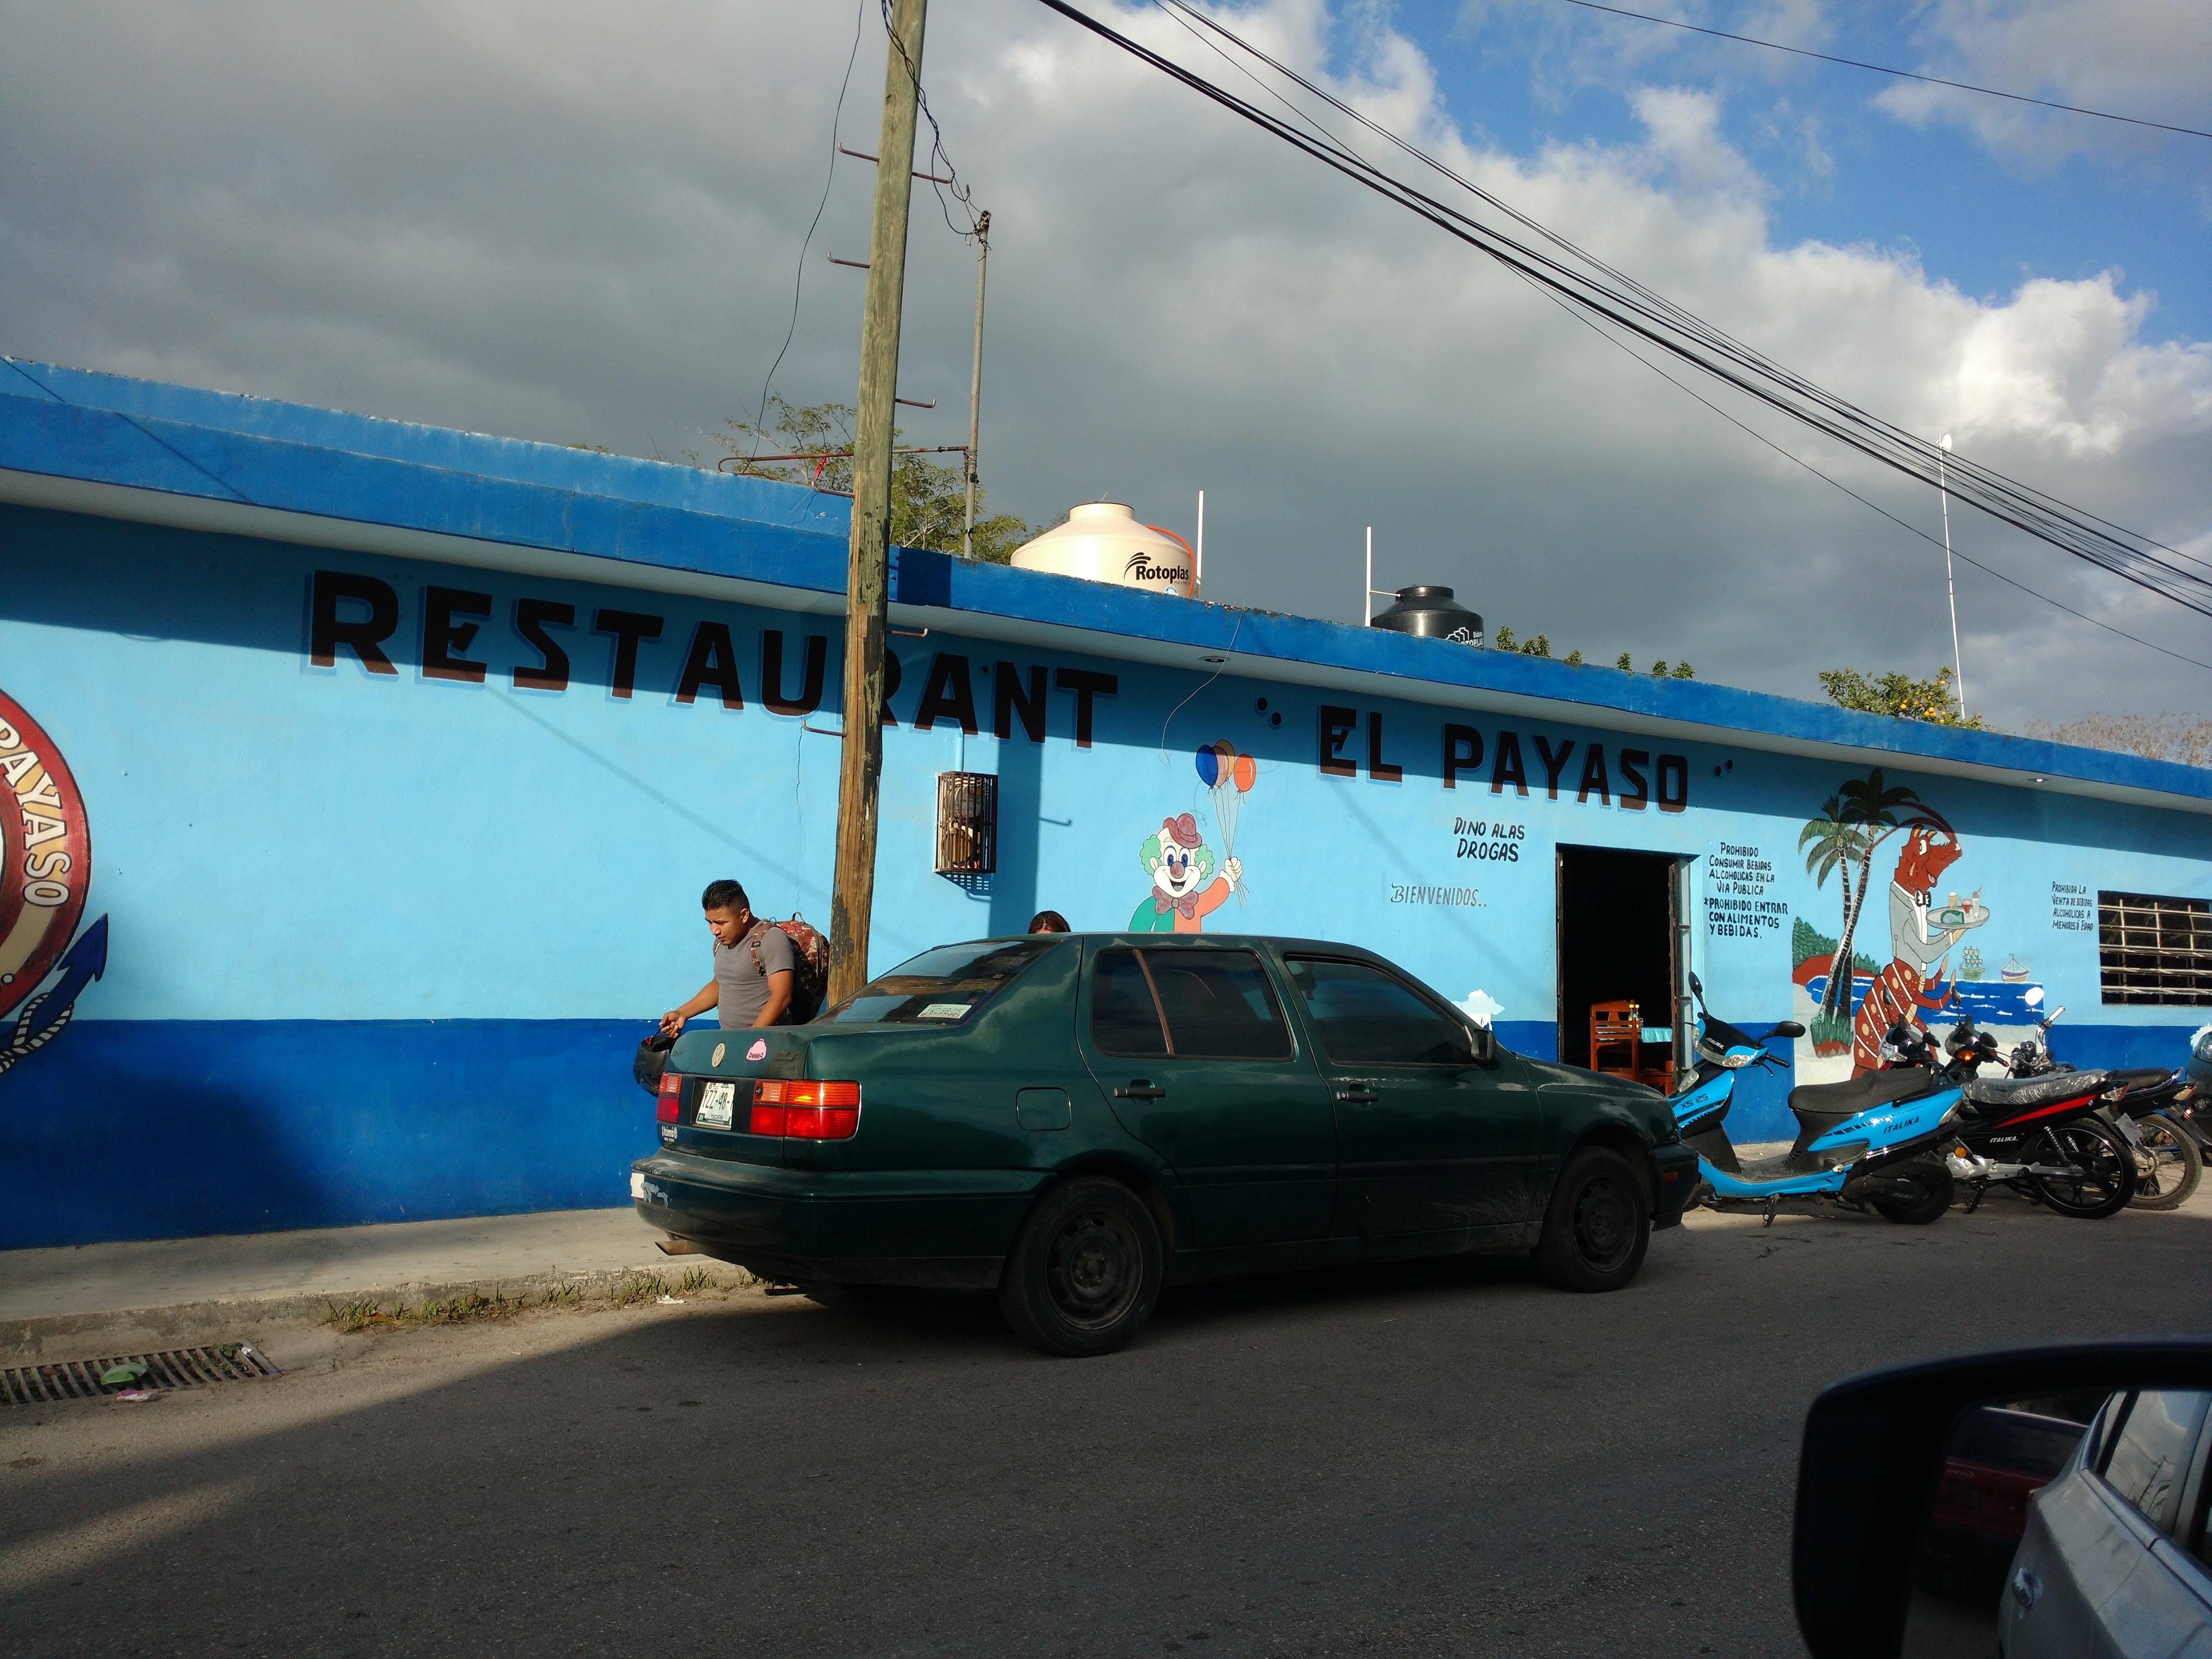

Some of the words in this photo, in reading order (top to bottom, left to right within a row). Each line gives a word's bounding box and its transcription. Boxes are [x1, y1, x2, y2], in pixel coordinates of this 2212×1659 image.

[1135, 565, 1189, 584] Rotoplas
[1319, 705, 1403, 783] EL
[1443, 723, 1688, 813] PAYASO
[1456, 838, 1519, 862] DROGAS
[1720, 841, 1759, 858] PROHIBIDO
[1709, 854, 1744, 869] CONSUMIR
[1747, 859, 1772, 871] BEBIDAS
[1709, 868, 1753, 882] ALCOHOLICAS
[1756, 872, 1765, 882] EN
[1766, 874, 1775, 883] LA
[1717, 880, 1730, 894] VIA
[1733, 882, 1764, 896] PUBLICA
[2052, 881, 2077, 894] PROHIBIDA
[2078, 885, 2086, 894] LA
[1755, 901, 1788, 915] ENTRAR
[2052, 893, 2069, 906] VENTA
[2071, 898, 2076, 906] DE
[2077, 898, 2093, 907] BEBIDAS
[1709, 912, 1725, 922] CON
[1727, 913, 1779, 929] ALIMENTOS
[2053, 908, 2084, 919] ALCOHOLICAS
[2087, 910, 2090, 919] A
[1709, 923, 1715, 935] Y
[2052, 919, 2076, 930] MENORES
[2081, 920, 2093, 931] EDAD
[1681, 1100, 1694, 1110] XS
[1695, 1094, 1709, 1104] 125
